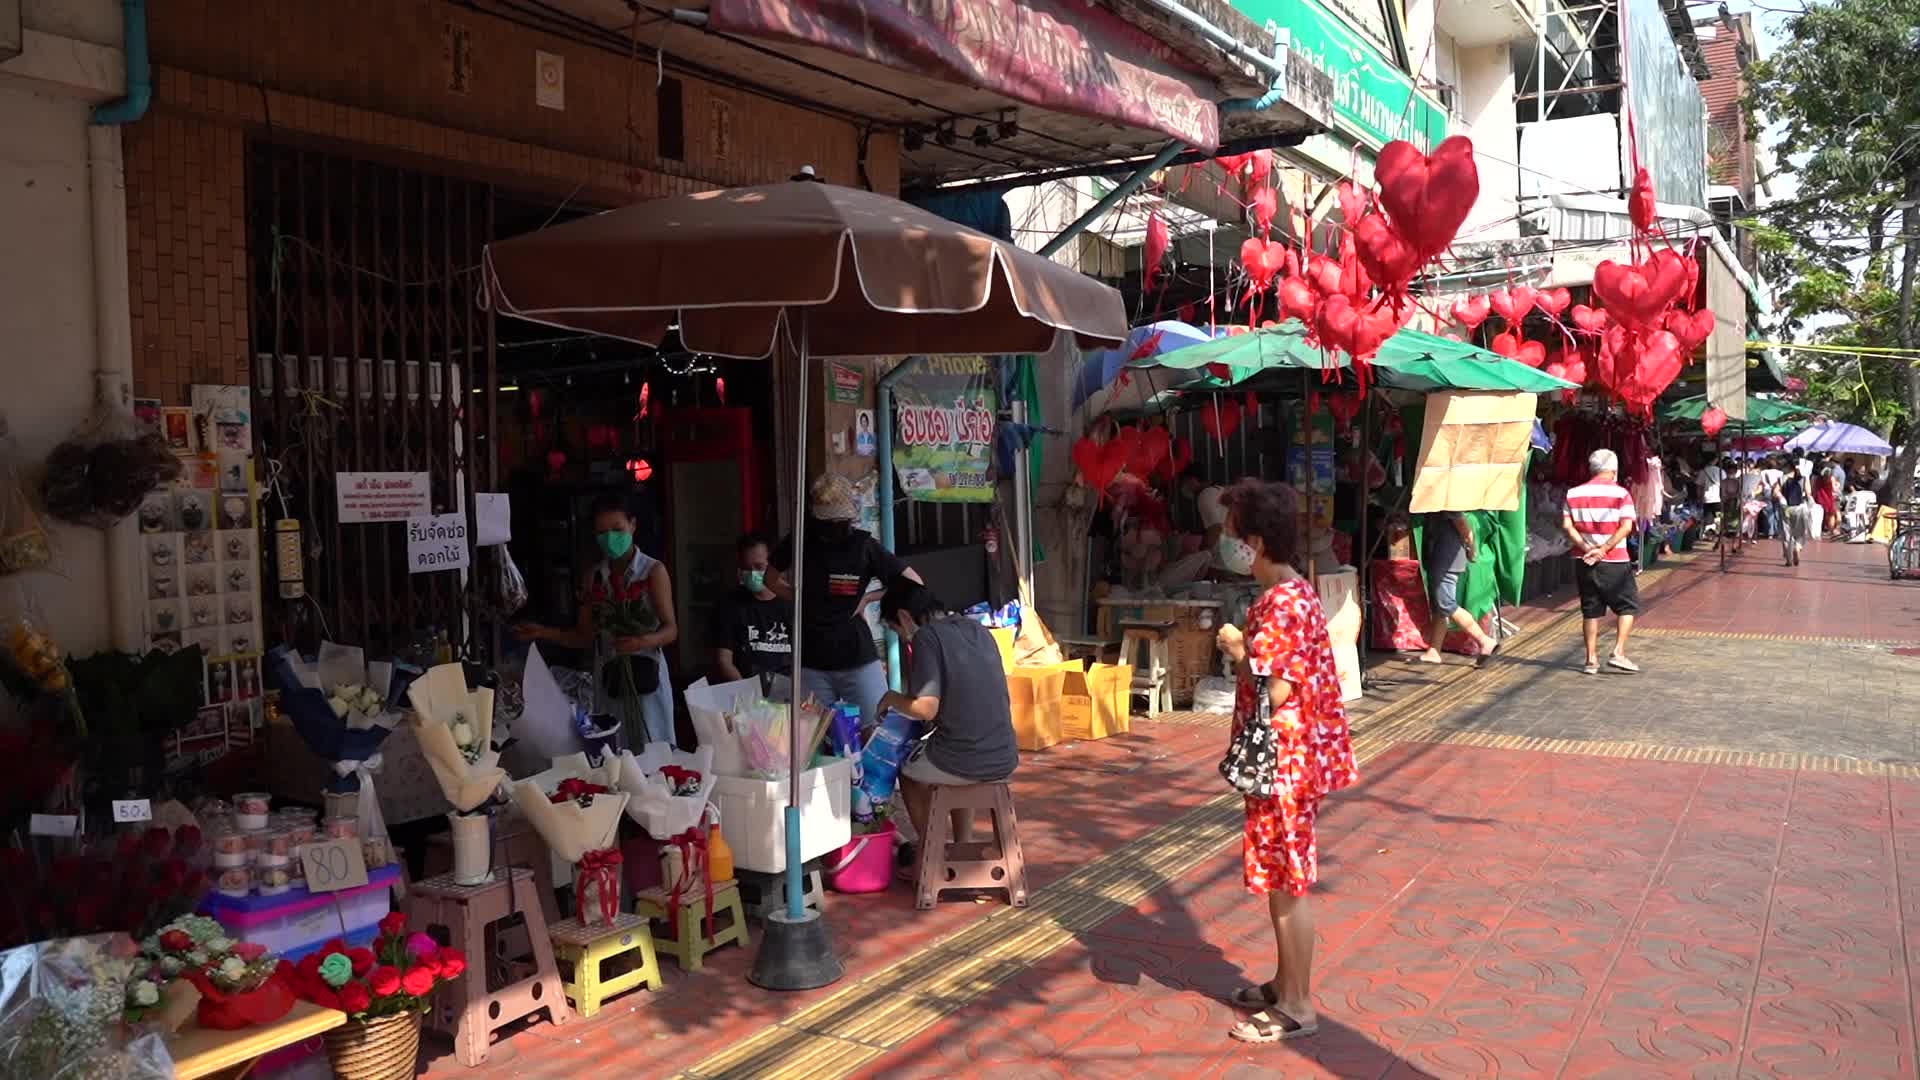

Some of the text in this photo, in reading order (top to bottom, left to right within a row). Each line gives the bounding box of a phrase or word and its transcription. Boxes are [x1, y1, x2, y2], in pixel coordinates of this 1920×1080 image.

[409, 521, 465, 543] รับจัดช่อ
[418, 545, 460, 566] ดอกไม้
[310, 846, 348, 885] 80
